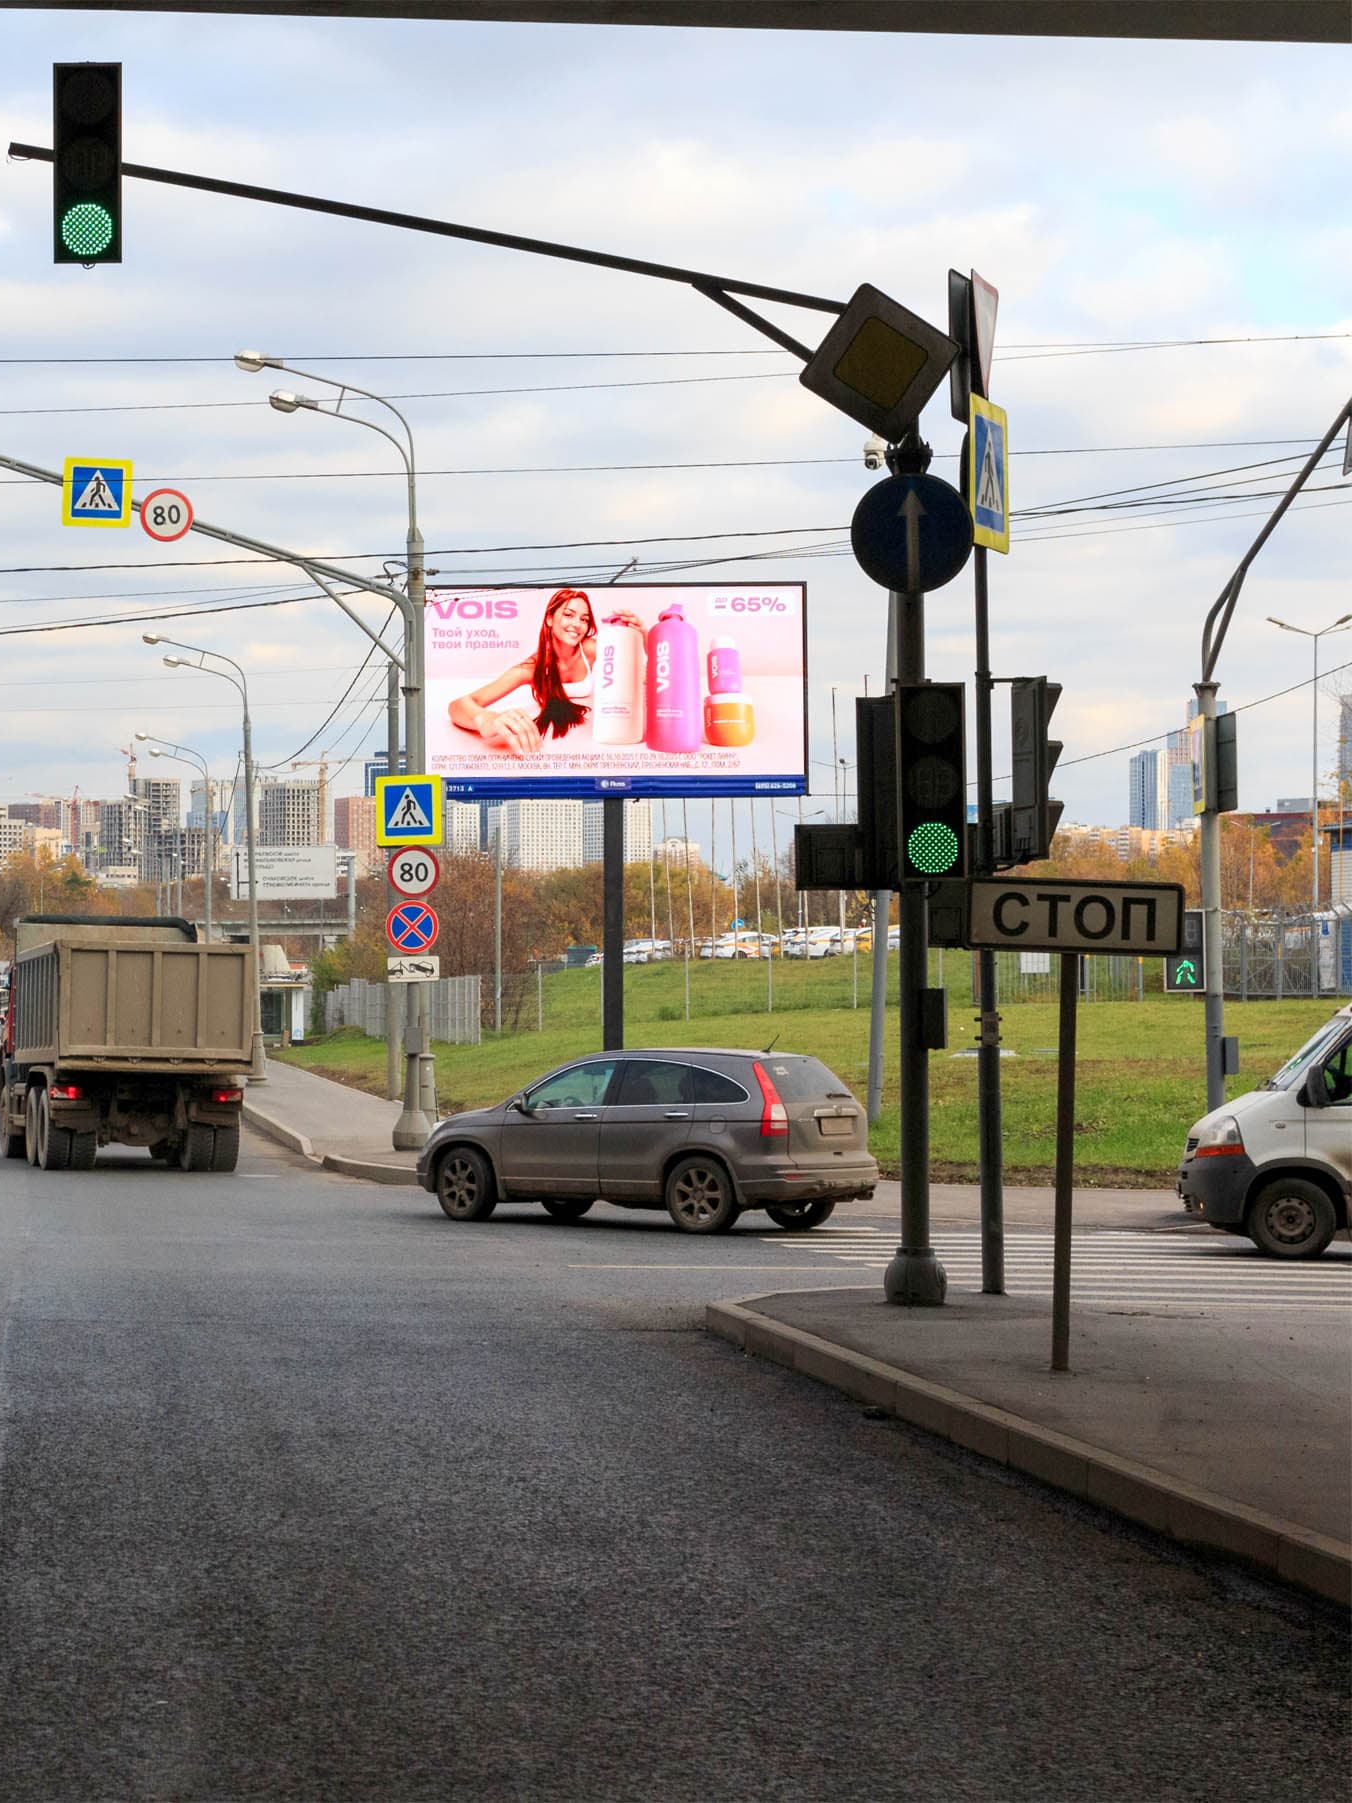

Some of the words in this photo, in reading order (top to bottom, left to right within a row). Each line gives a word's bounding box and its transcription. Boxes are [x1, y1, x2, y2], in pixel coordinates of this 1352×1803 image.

[153, 504, 181, 526] 80
[432, 600, 518, 619] VOIS
[432, 627, 462, 638] Твой
[466, 629, 500, 639] уход,
[432, 641, 462, 649] твои
[465, 640, 520, 650] правила
[602, 645, 615, 688] VOIS
[656, 641, 670, 693] VOIS
[711, 655, 720, 679] VOIS
[399, 862, 429, 882] 80
[992, 891, 1157, 942] СТОП
